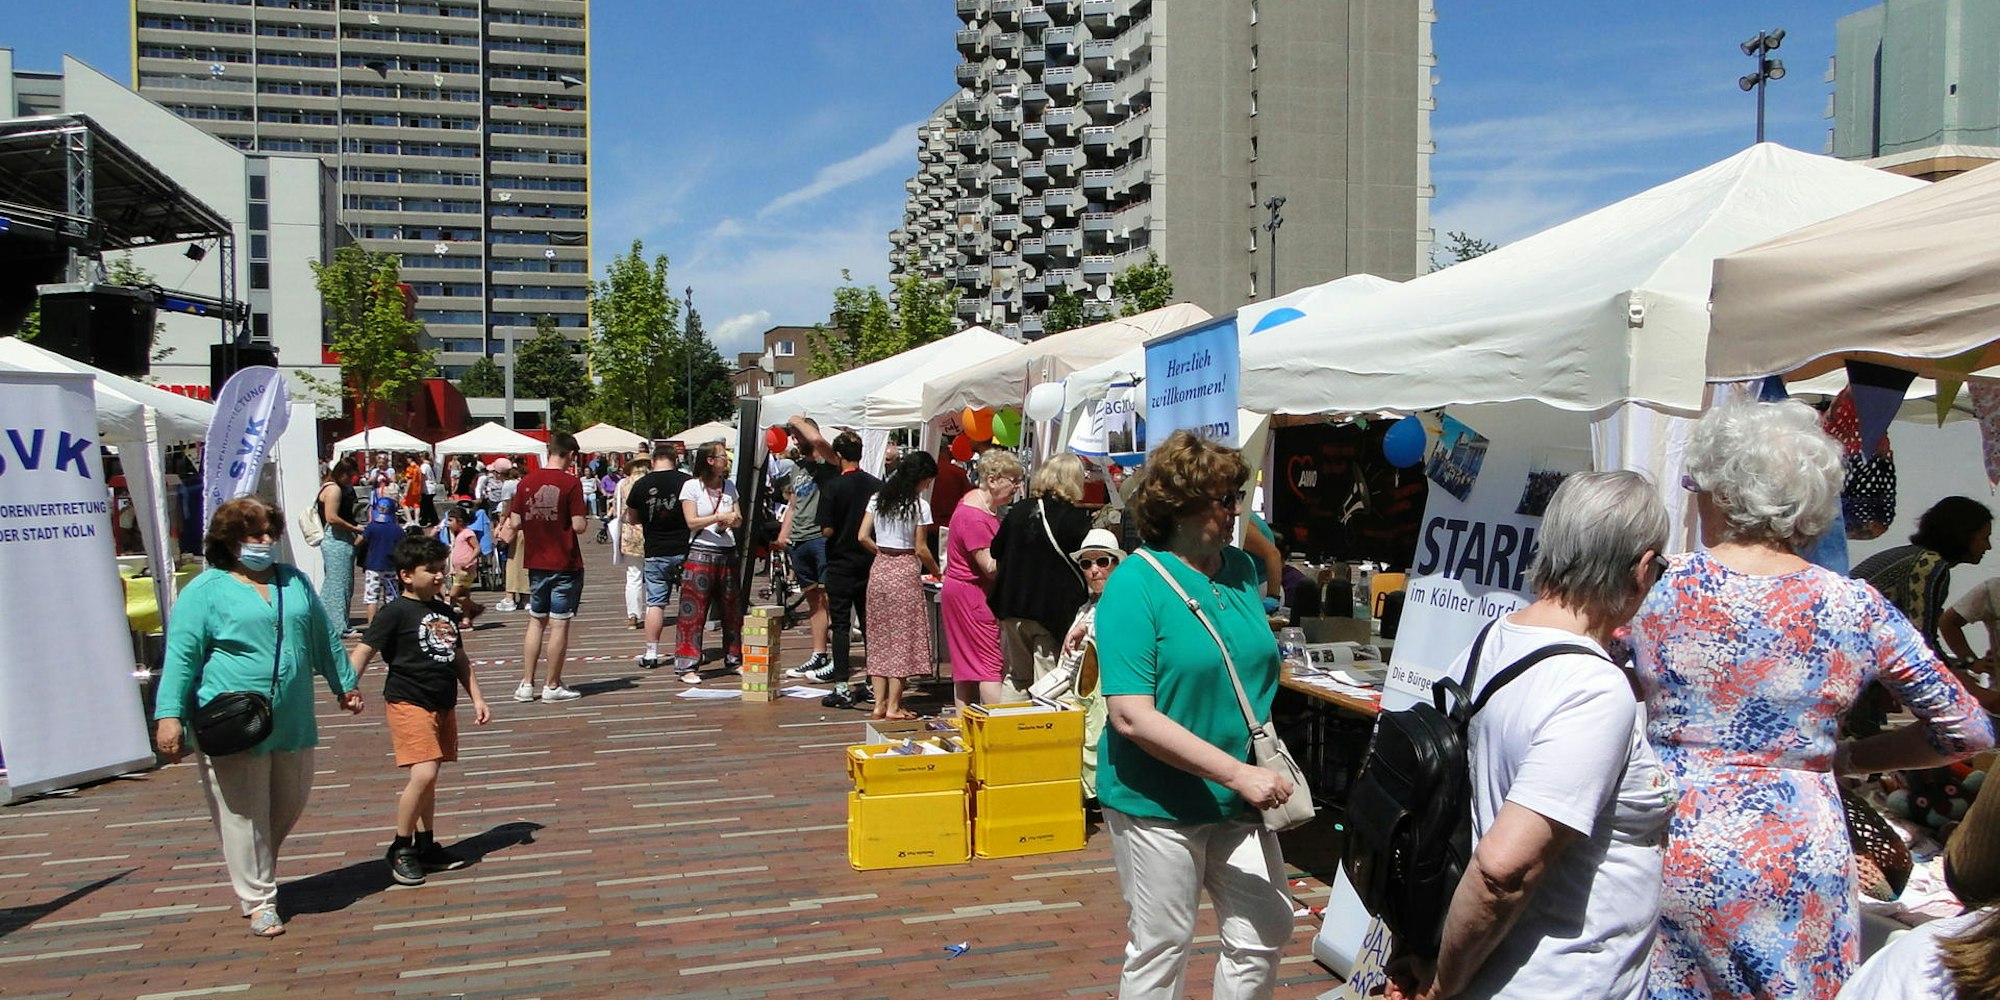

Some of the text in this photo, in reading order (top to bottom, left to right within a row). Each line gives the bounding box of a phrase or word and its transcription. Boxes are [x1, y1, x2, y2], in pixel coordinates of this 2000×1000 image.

[1166, 349, 1211, 378] Herzlich
[1151, 373, 1227, 408] willkommen!
[0, 429, 93, 479] VK
[229, 415, 266, 480] SVK
[1297, 470, 1318, 488] AWO
[22, 526, 59, 541] STADT
[63, 523, 96, 538] KÖLN
[1410, 582, 1426, 603] im
[1430, 587, 1475, 613] Kölner
[1392, 666, 1434, 692] Die Bürge
